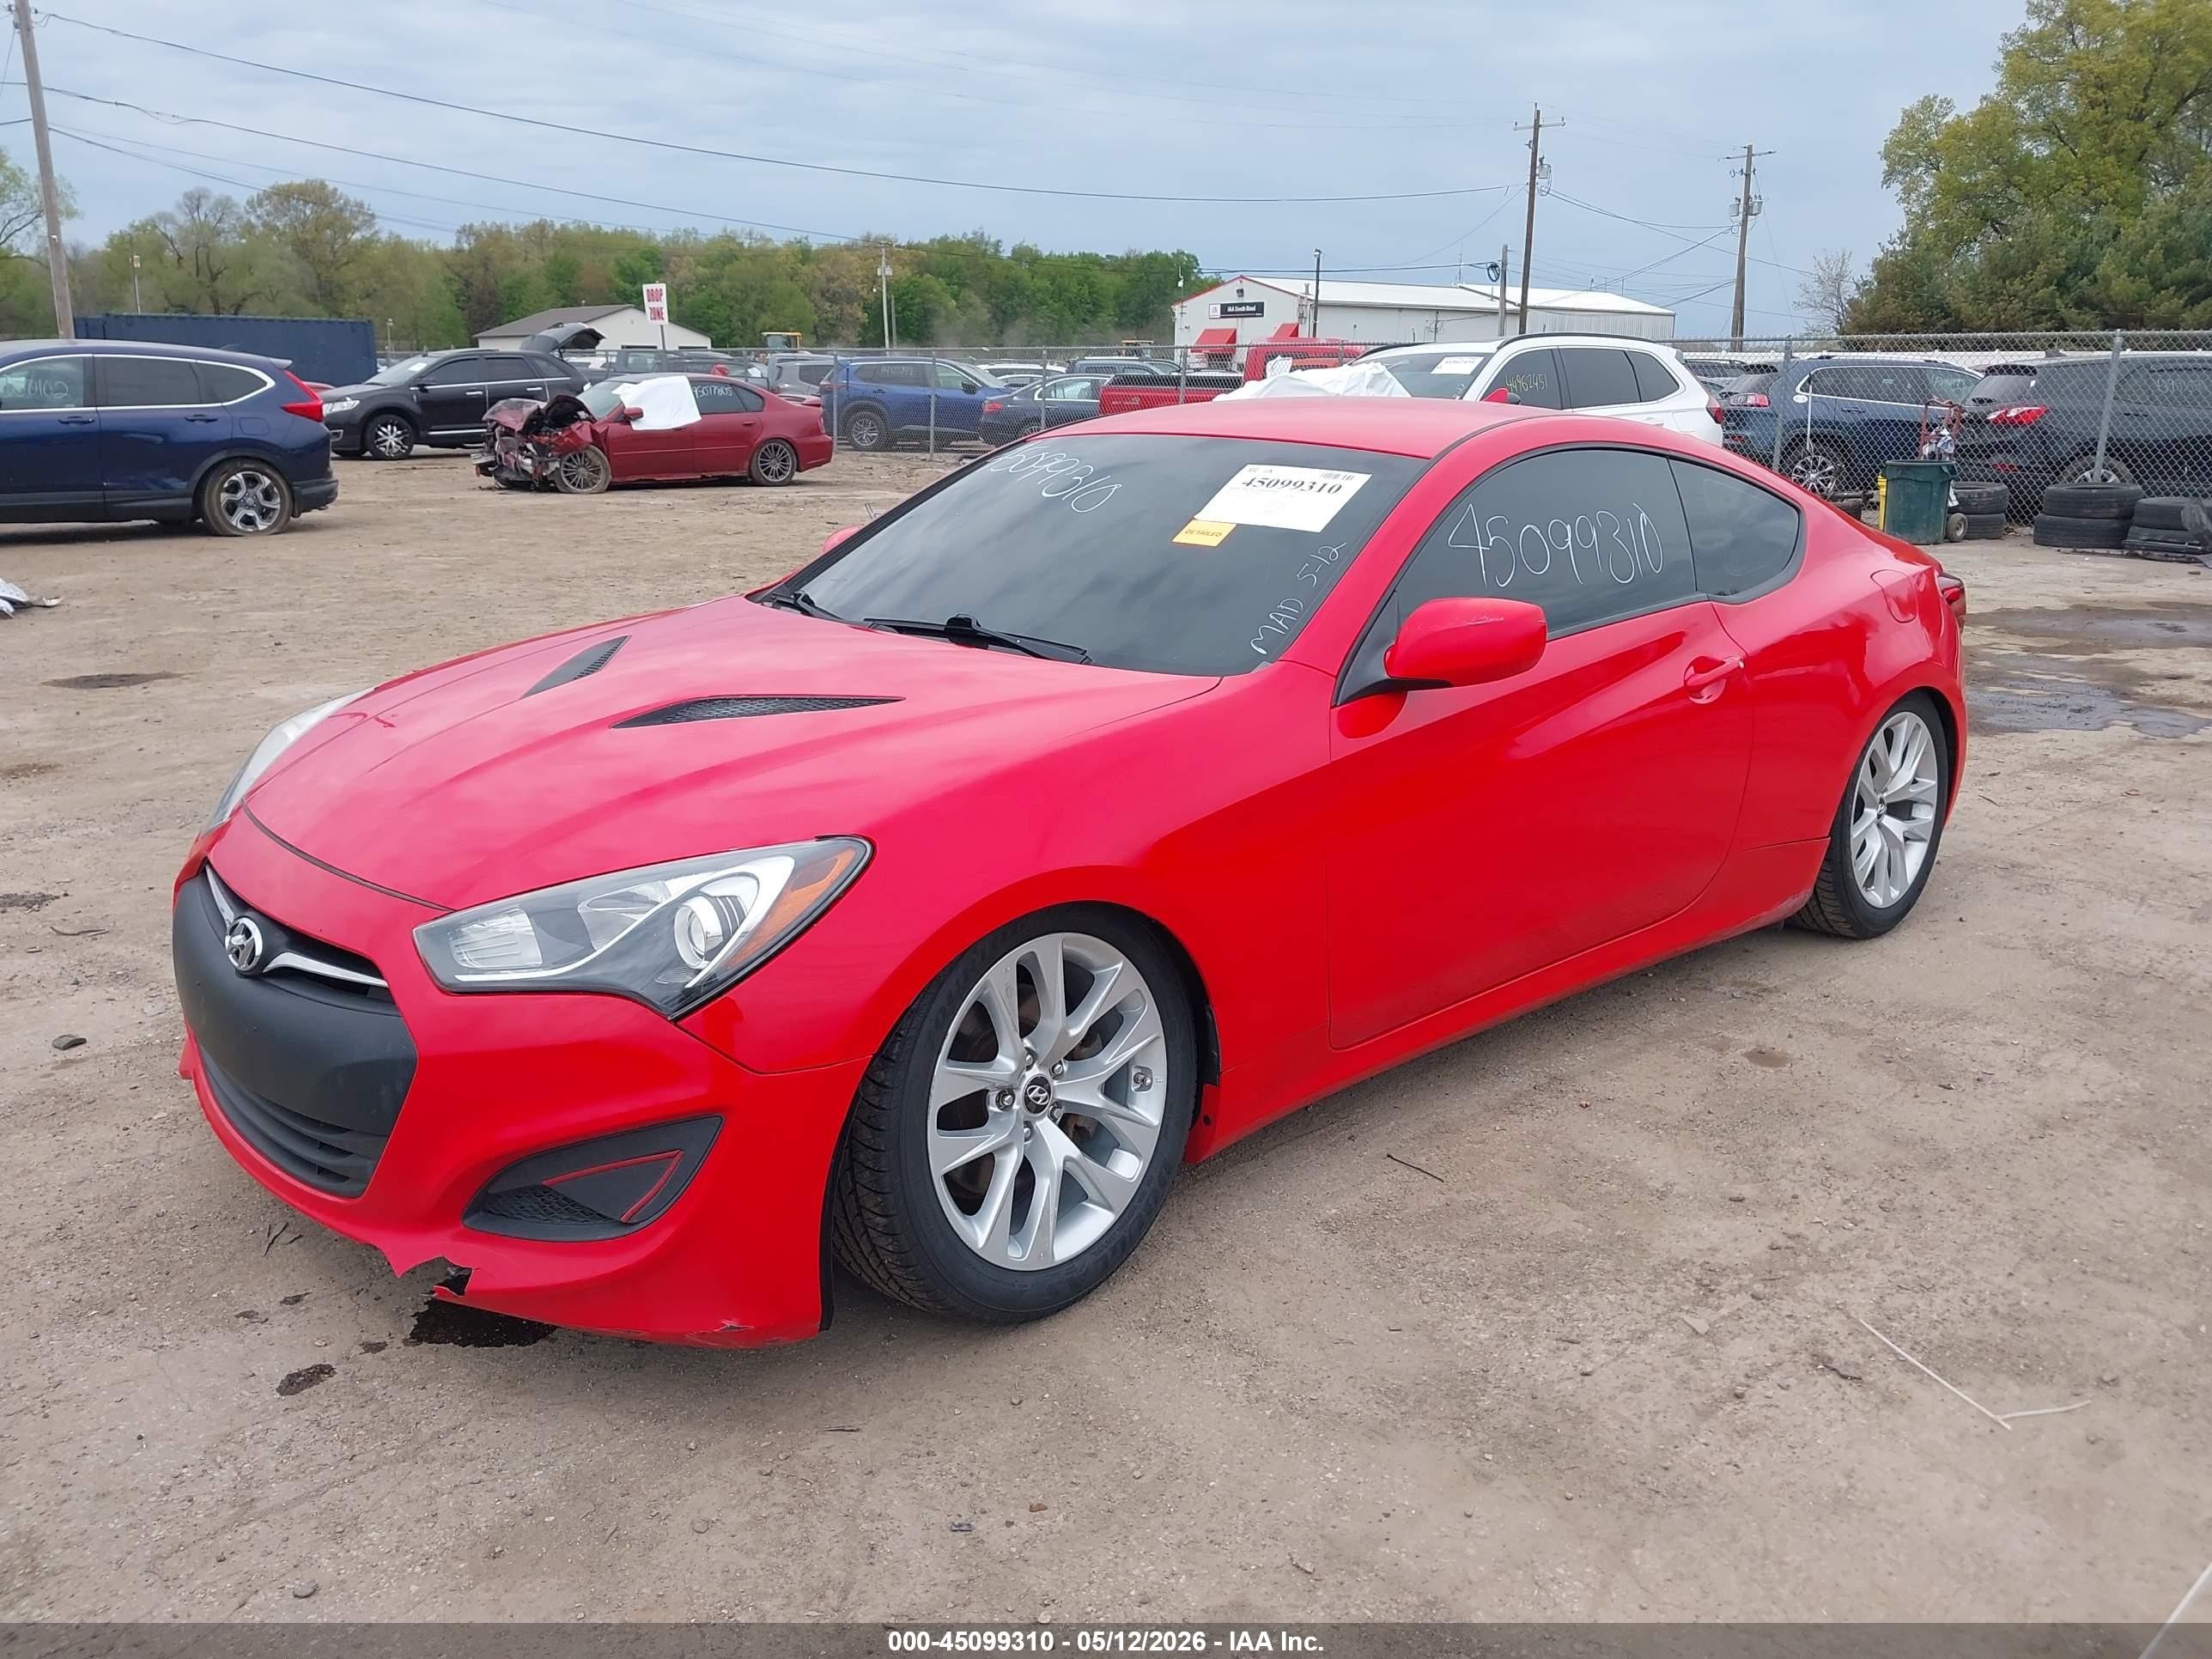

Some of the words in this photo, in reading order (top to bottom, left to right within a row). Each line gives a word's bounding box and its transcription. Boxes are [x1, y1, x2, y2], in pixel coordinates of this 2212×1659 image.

[647, 288, 663, 302] DROP
[649, 307, 664, 320] ZONE
[1242, 477, 1342, 495] 45099310
[1185, 528, 1223, 538] DETAILED
[1448, 502, 1663, 588] 45099310
[1250, 598, 1304, 655] MAD
[1296, 542, 1347, 588] 5-12
